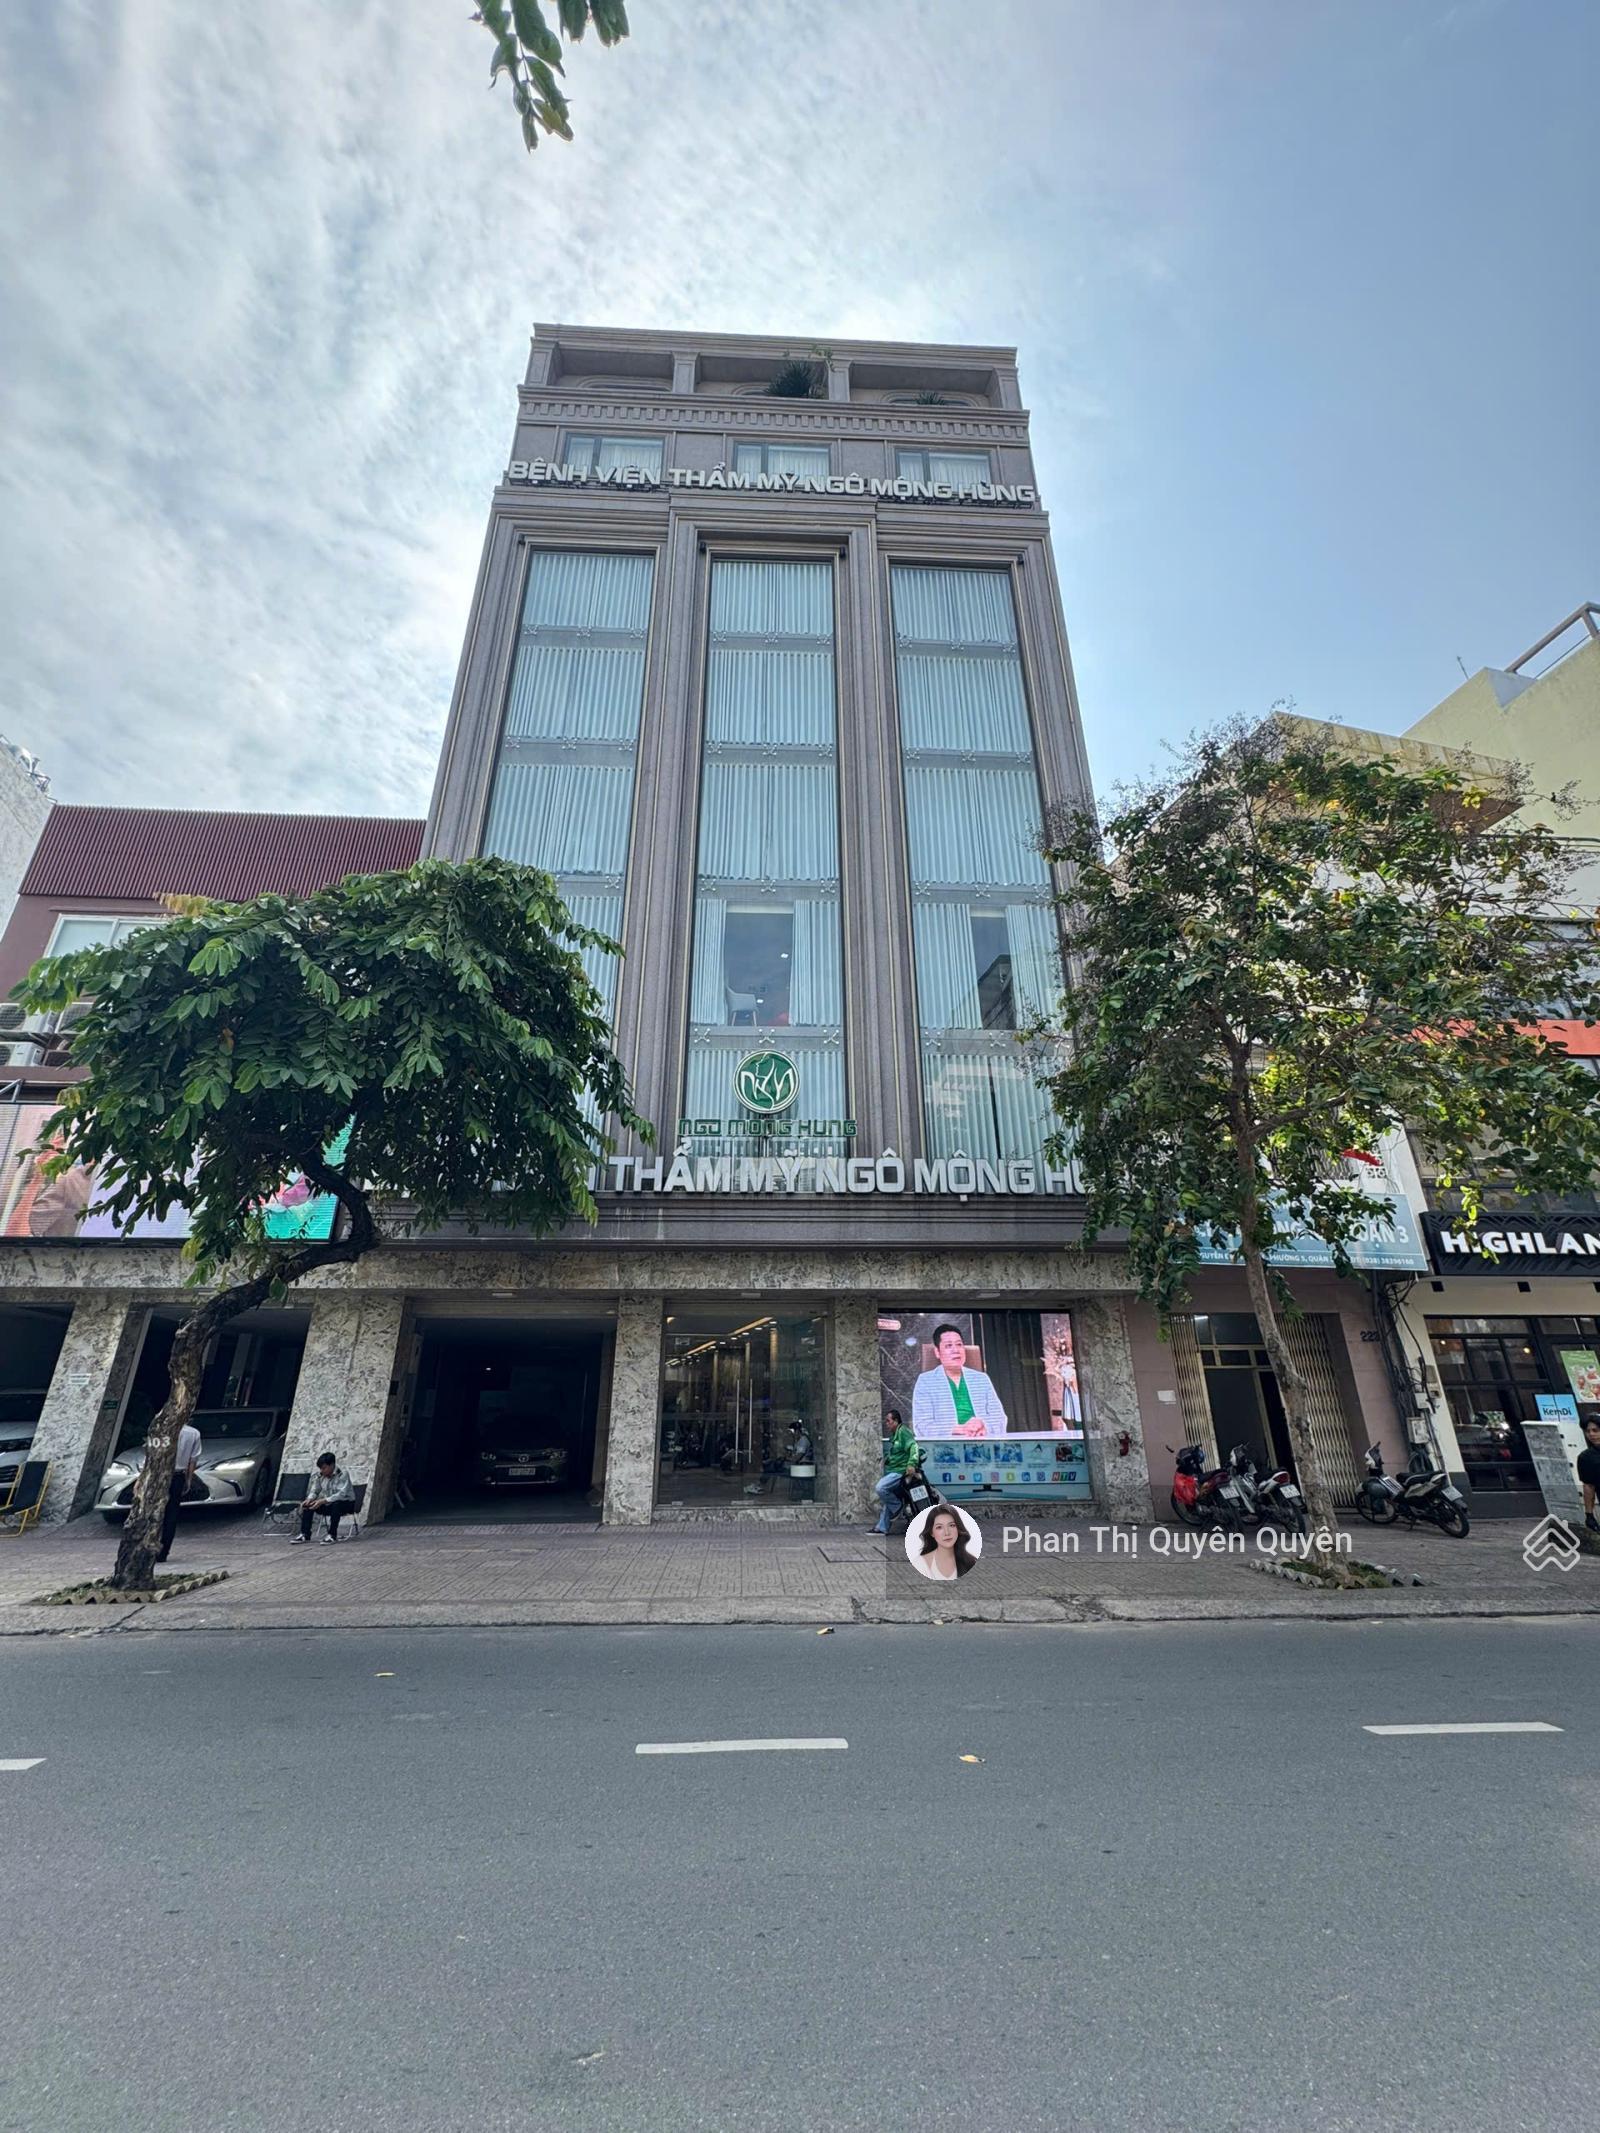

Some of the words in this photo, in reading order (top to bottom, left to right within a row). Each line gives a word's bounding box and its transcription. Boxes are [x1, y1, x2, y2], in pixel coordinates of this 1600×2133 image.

[509, 456, 587, 484] BỆNH
[669, 461, 751, 489] THẨM
[804, 472, 866, 495] NGÔ
[870, 475, 953, 500] MỘNG
[958, 480, 1036, 502] HÙNG
[608, 1137, 731, 1192] THẨM
[739, 1149, 801, 1193] MỸ
[814, 1146, 906, 1194] NGÔ
[913, 1149, 1036, 1202] MỘNG
[1043, 1158, 1087, 1195] HU
[1397, 1225, 1409, 1244] 3
